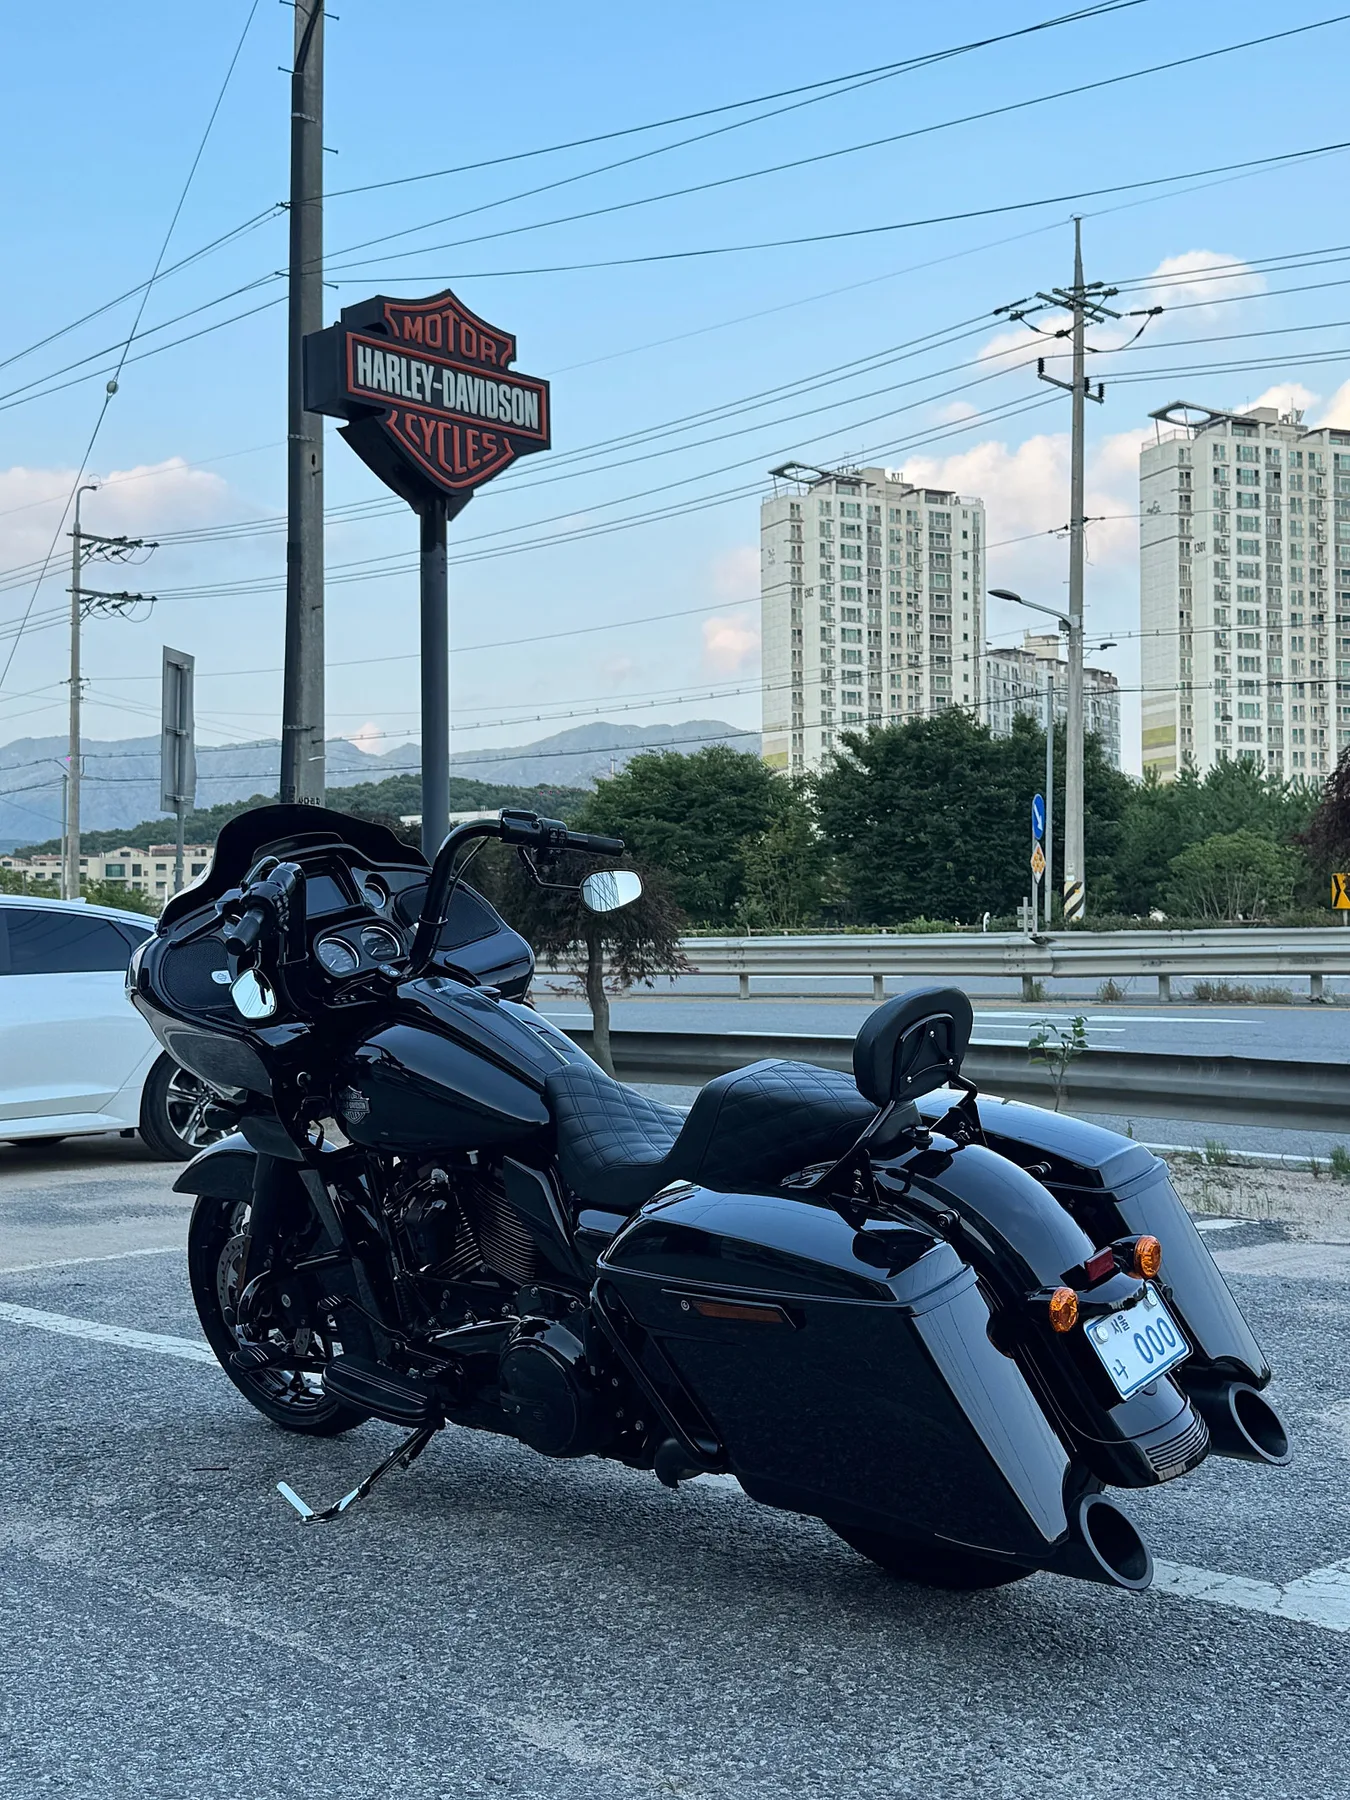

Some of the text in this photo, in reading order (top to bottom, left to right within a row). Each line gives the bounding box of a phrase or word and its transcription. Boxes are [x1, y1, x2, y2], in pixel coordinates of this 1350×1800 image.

[403, 309, 496, 365] MOTOR
[357, 345, 539, 429] HARLEY-DAVIDSON
[405, 413, 497, 474] CYCLES
[1111, 1314, 1130, 1335] 서울
[1113, 1317, 1176, 1379] 나 000
